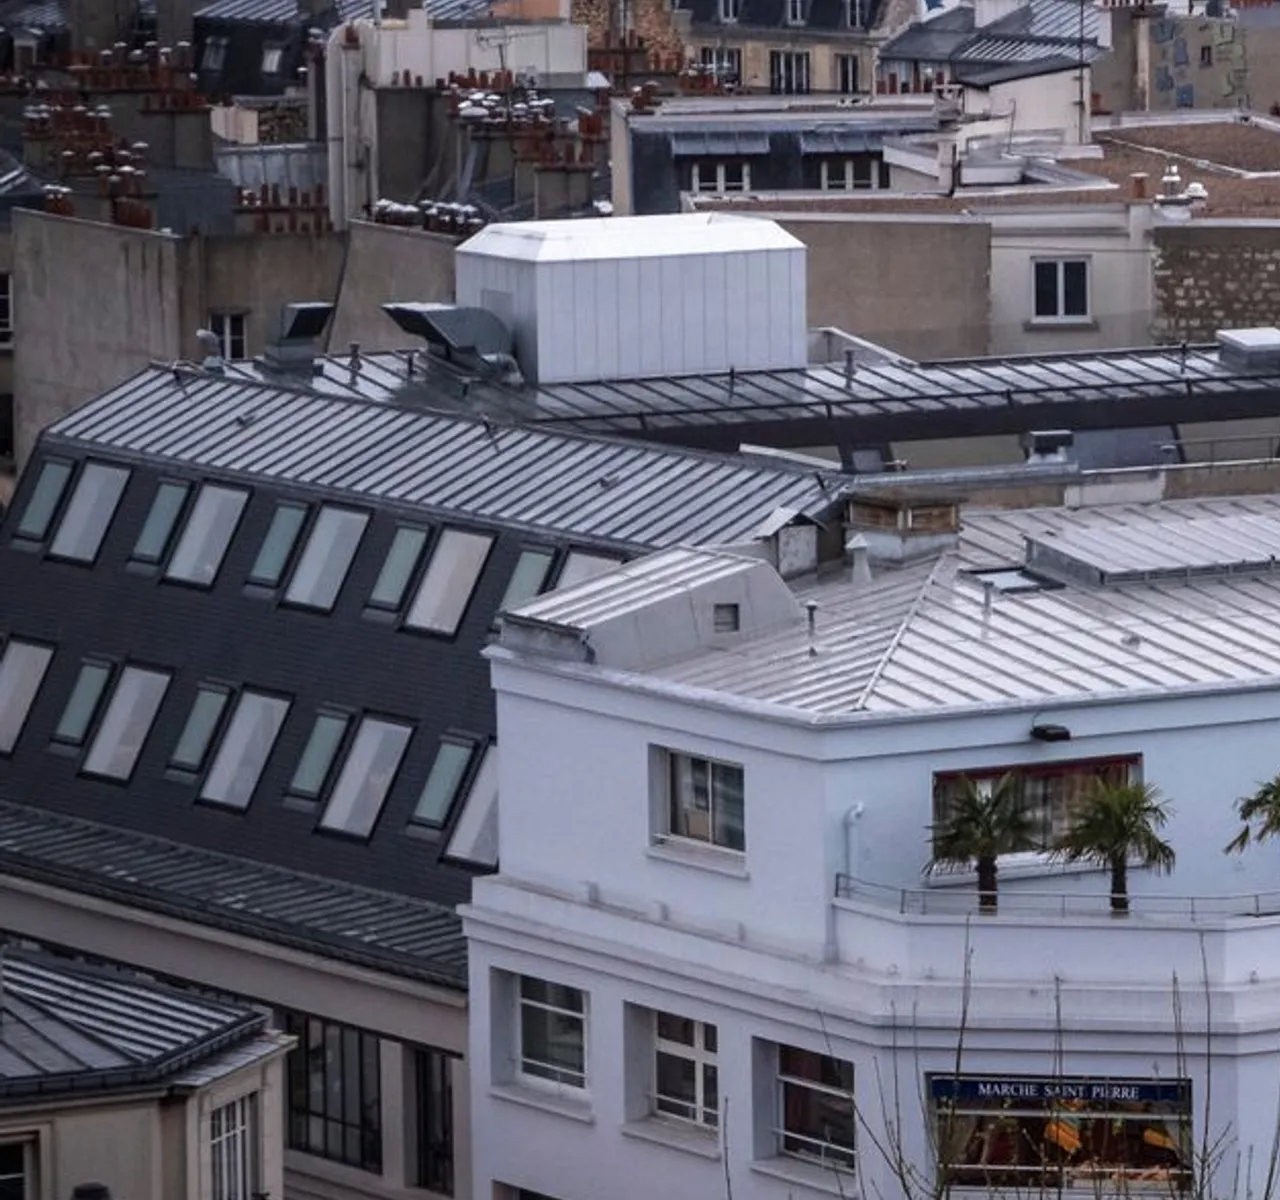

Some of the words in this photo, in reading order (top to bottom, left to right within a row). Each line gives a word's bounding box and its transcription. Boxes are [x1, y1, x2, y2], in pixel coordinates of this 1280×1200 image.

[978, 1083, 1038, 1096] MARCHE
[1043, 1084, 1085, 1097] SAINT
[1092, 1085, 1140, 1099] PIERRE
